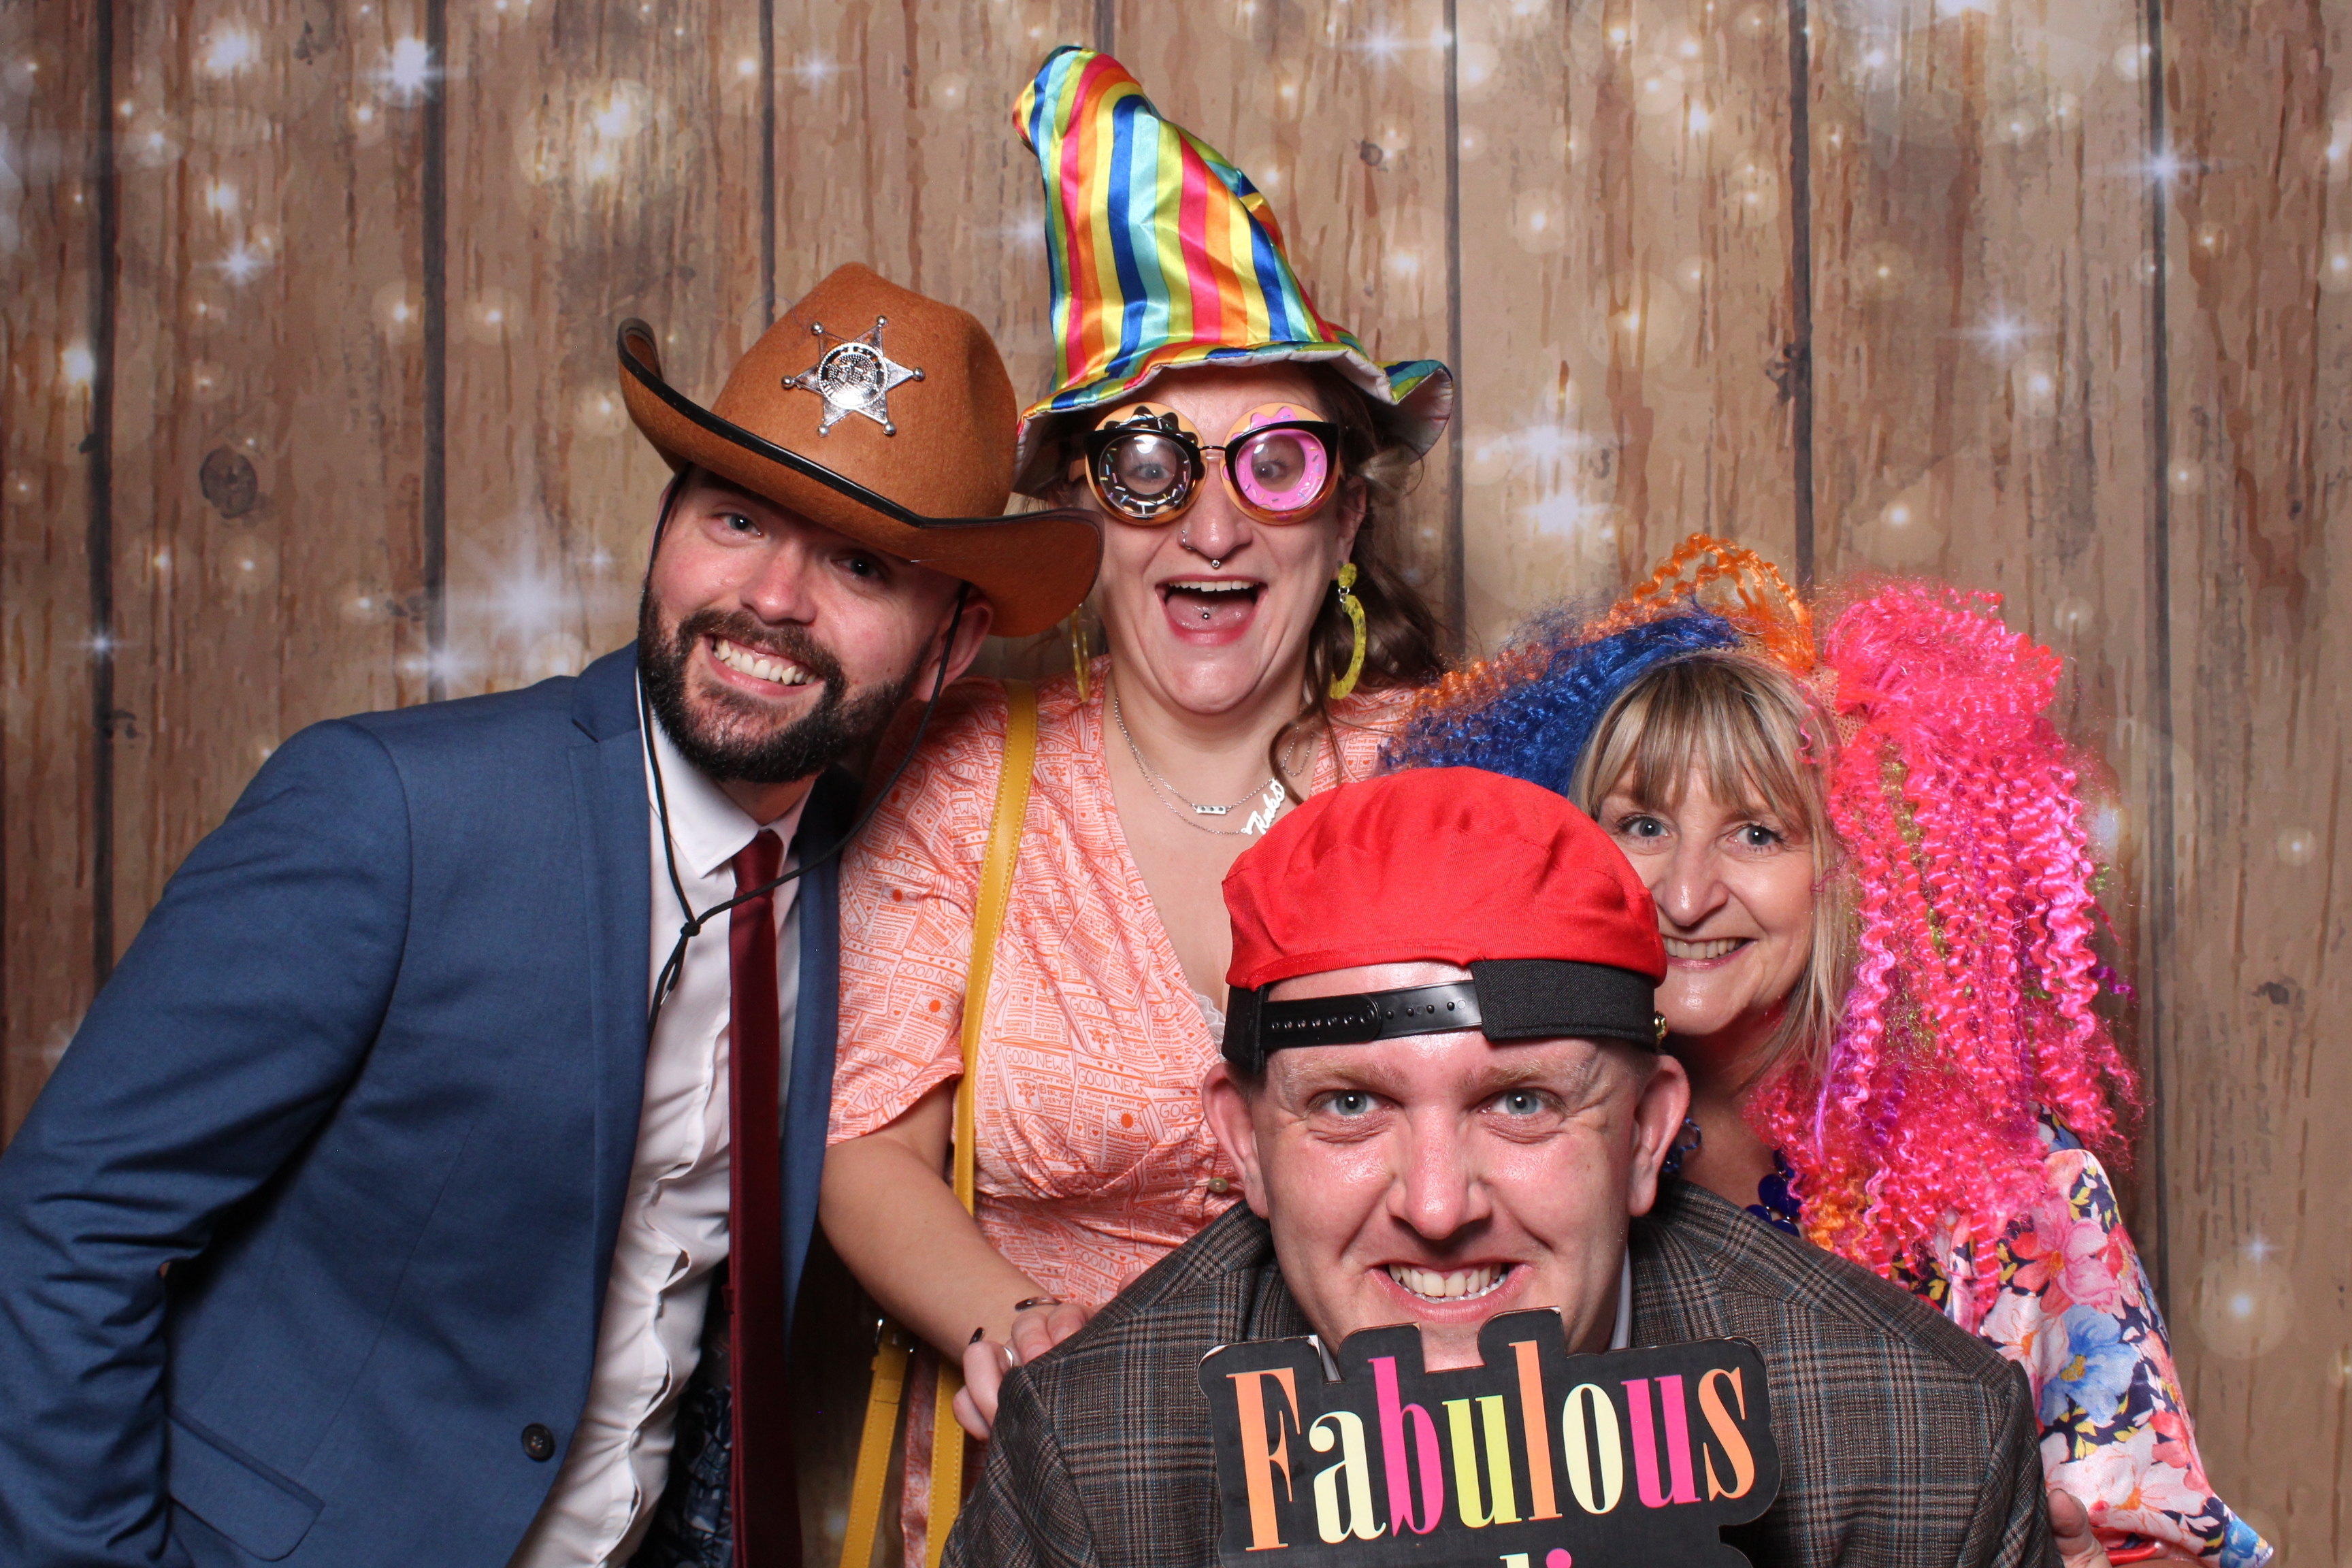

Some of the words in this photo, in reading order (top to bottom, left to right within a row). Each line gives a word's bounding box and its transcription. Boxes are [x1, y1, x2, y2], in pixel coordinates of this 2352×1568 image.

[860, 957, 895, 976] NEWS
[896, 962, 934, 979] GOOD
[1070, 996, 1102, 1015] GOOD
[1035, 1021, 1060, 1030] XOXOX
[901, 1034, 927, 1045] XOXOX
[1006, 1047, 1034, 1065] GOOD
[1036, 1053, 1072, 1075] NEWS
[1033, 1073, 1054, 1083] LOVELY
[1078, 1068, 1111, 1088] GOOD
[1113, 1077, 1145, 1095] NEW
[1087, 1091, 1102, 1099] MUCH
[1075, 1247, 1106, 1270] GOOD
[1226, 1340, 1755, 1551] Fabulous
